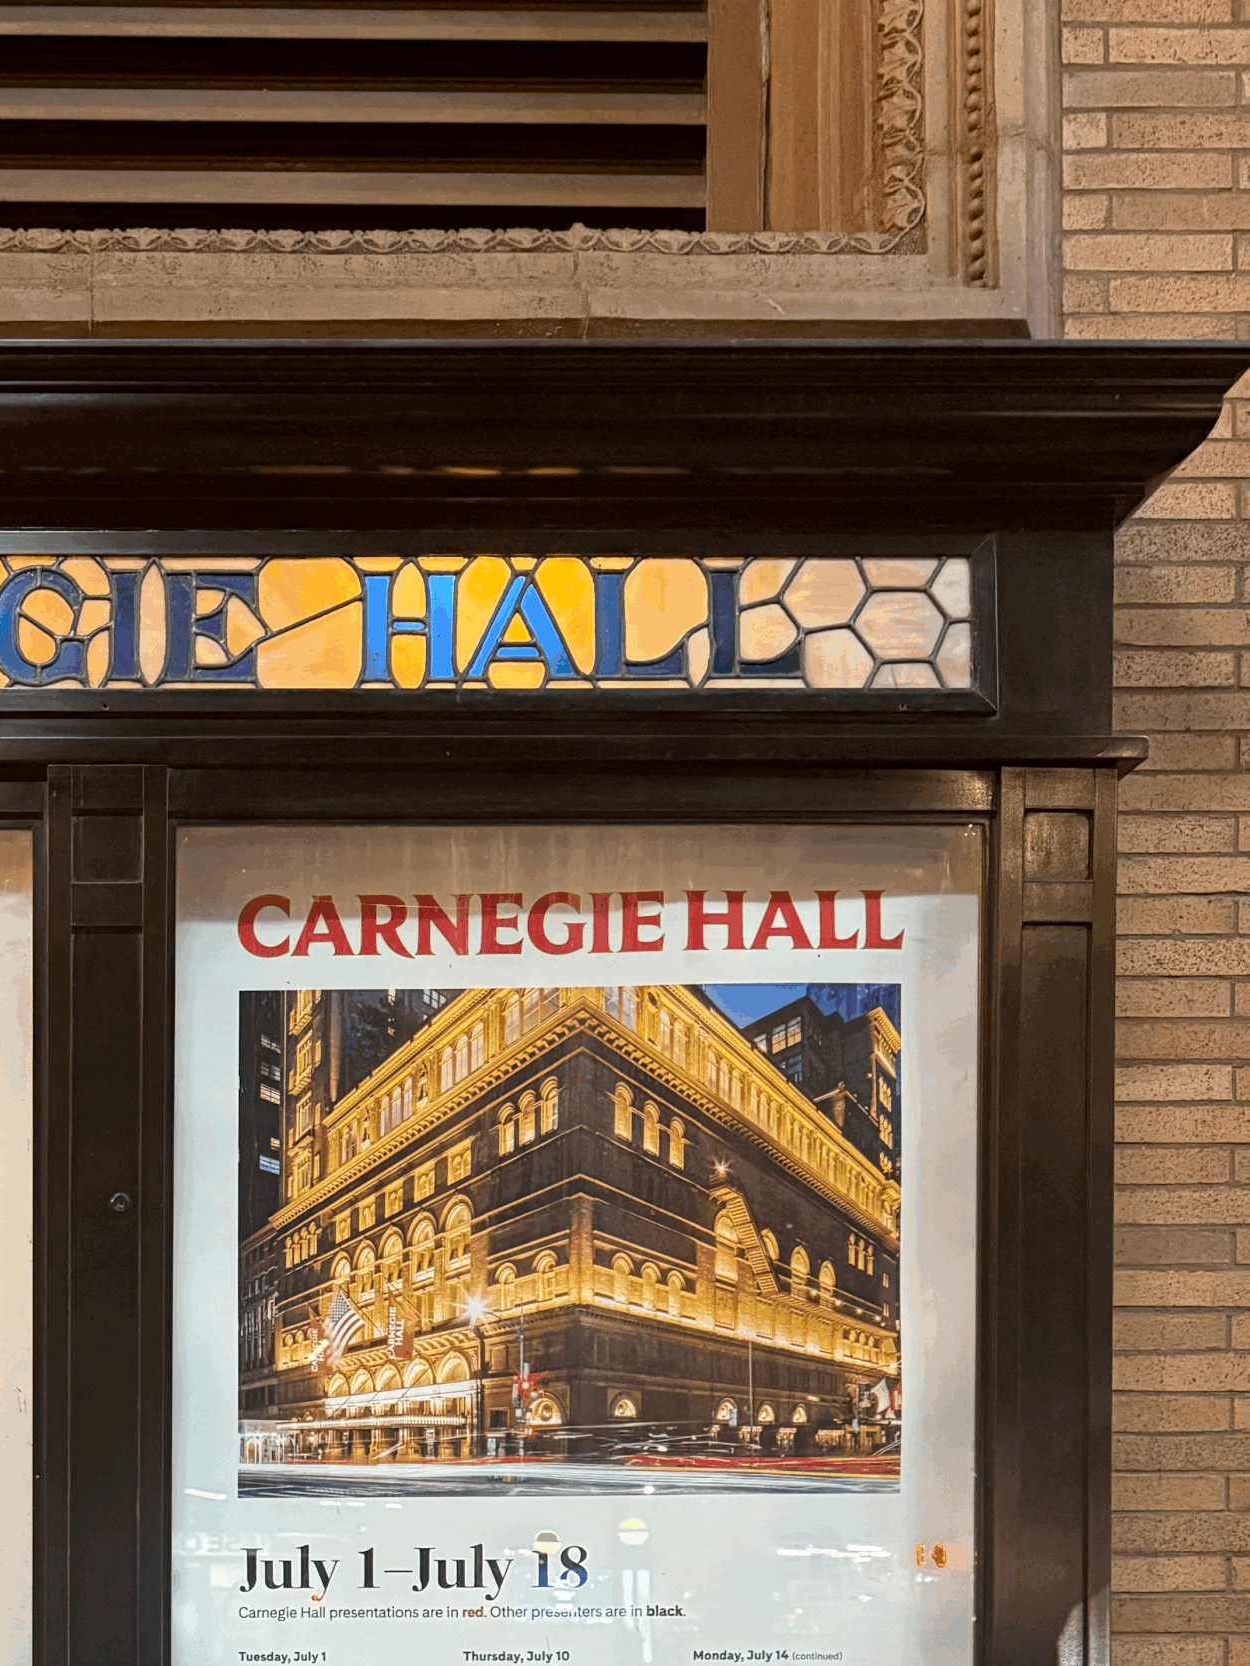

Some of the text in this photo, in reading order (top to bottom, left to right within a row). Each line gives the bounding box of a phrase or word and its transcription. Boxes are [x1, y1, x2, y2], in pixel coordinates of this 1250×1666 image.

[359, 570, 806, 680] HALL
[237, 889, 906, 959] CARNEGIE HALL
[239, 1543, 588, 1602] July 1–July 18
[238, 1604, 687, 1622] Carnegie Hall presentations are in red. Other presenters are in black.
[237, 1651, 327, 1665] Tuesday, July 1
[462, 1650, 570, 1664] Thursday, July 10
[692, 1649, 843, 1663] Monday, July 14 (continued)
